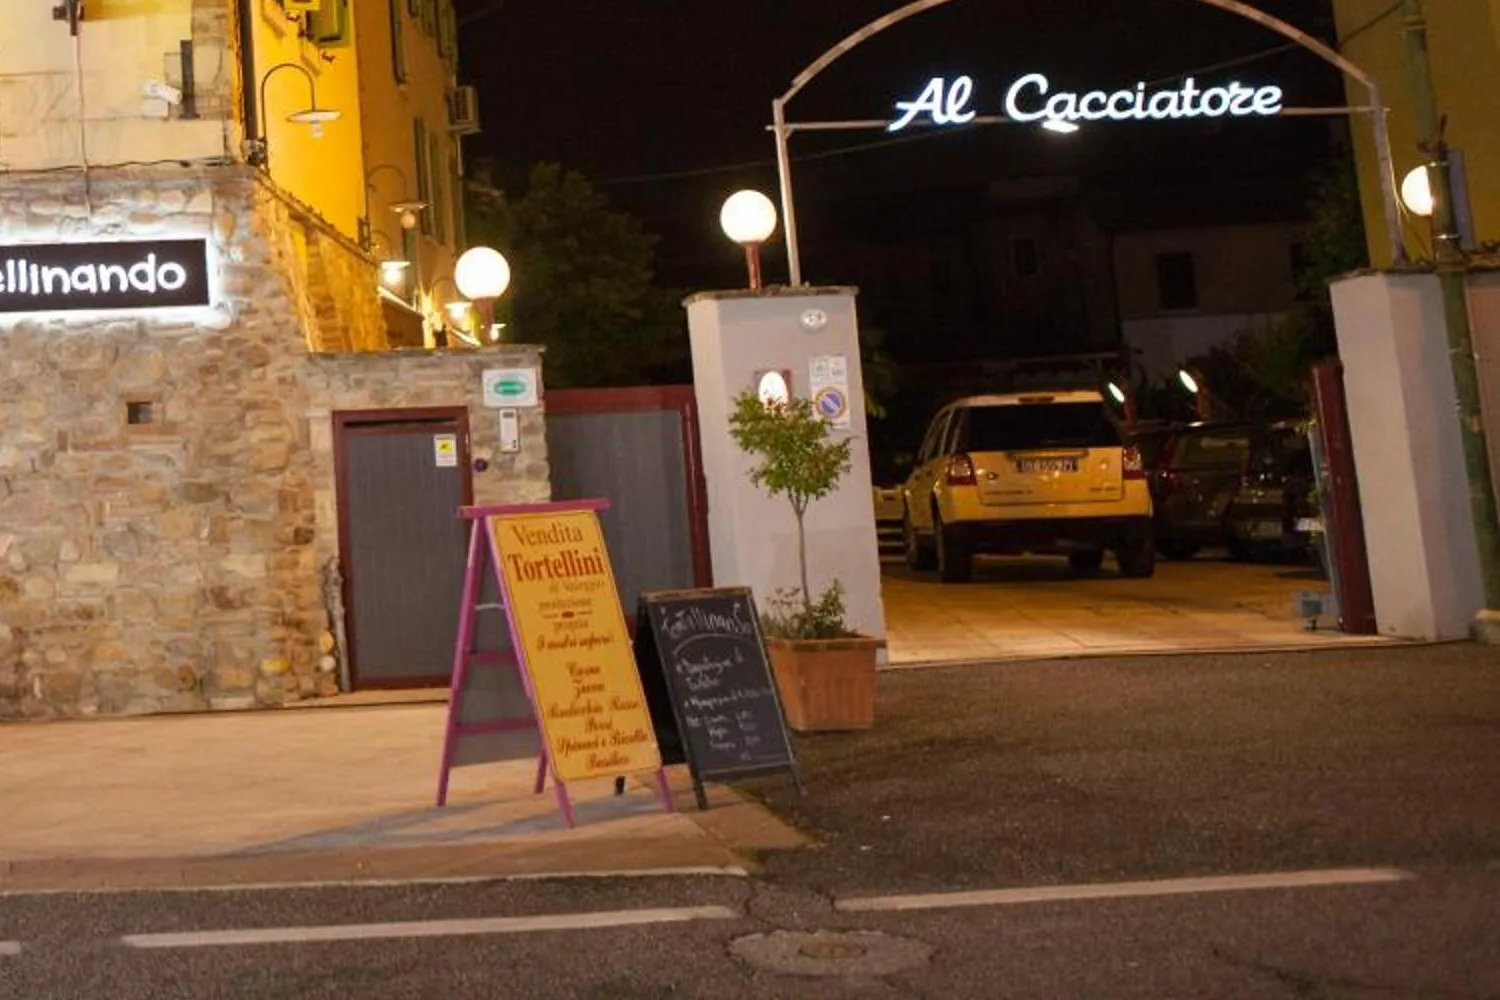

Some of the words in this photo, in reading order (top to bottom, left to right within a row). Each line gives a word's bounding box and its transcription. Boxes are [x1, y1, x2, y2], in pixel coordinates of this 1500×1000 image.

[886, 75, 976, 132] Al
[1005, 73, 1282, 121] Cacciatore
[511, 521, 584, 547] Vendita
[507, 546, 606, 583] Tortellini
